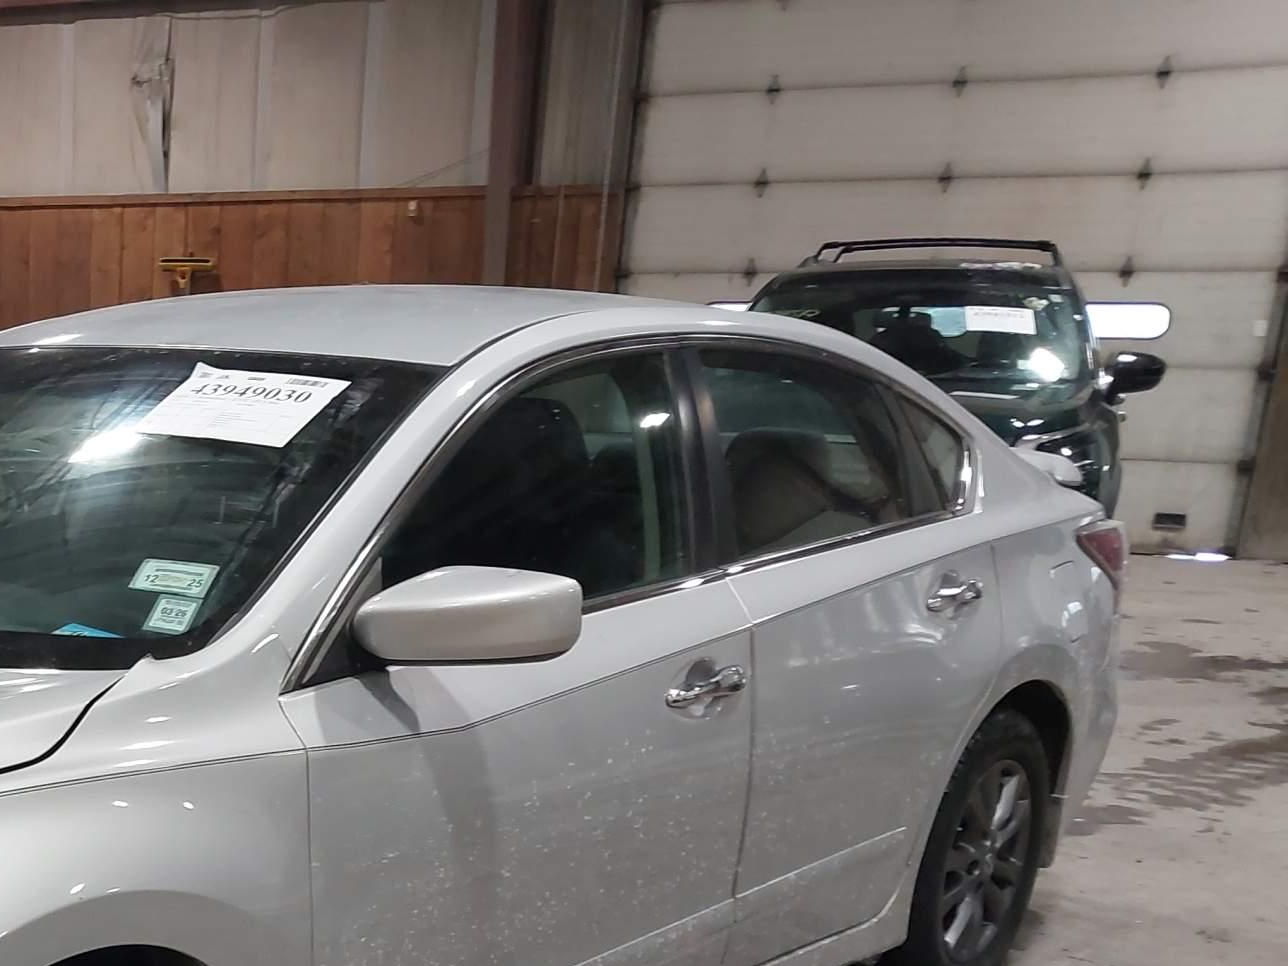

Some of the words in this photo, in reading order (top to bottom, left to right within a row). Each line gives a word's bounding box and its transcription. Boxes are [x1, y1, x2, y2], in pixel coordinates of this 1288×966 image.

[190, 383, 313, 403] 43949030
[144, 574, 160, 584] 12
[187, 579, 204, 588] 25
